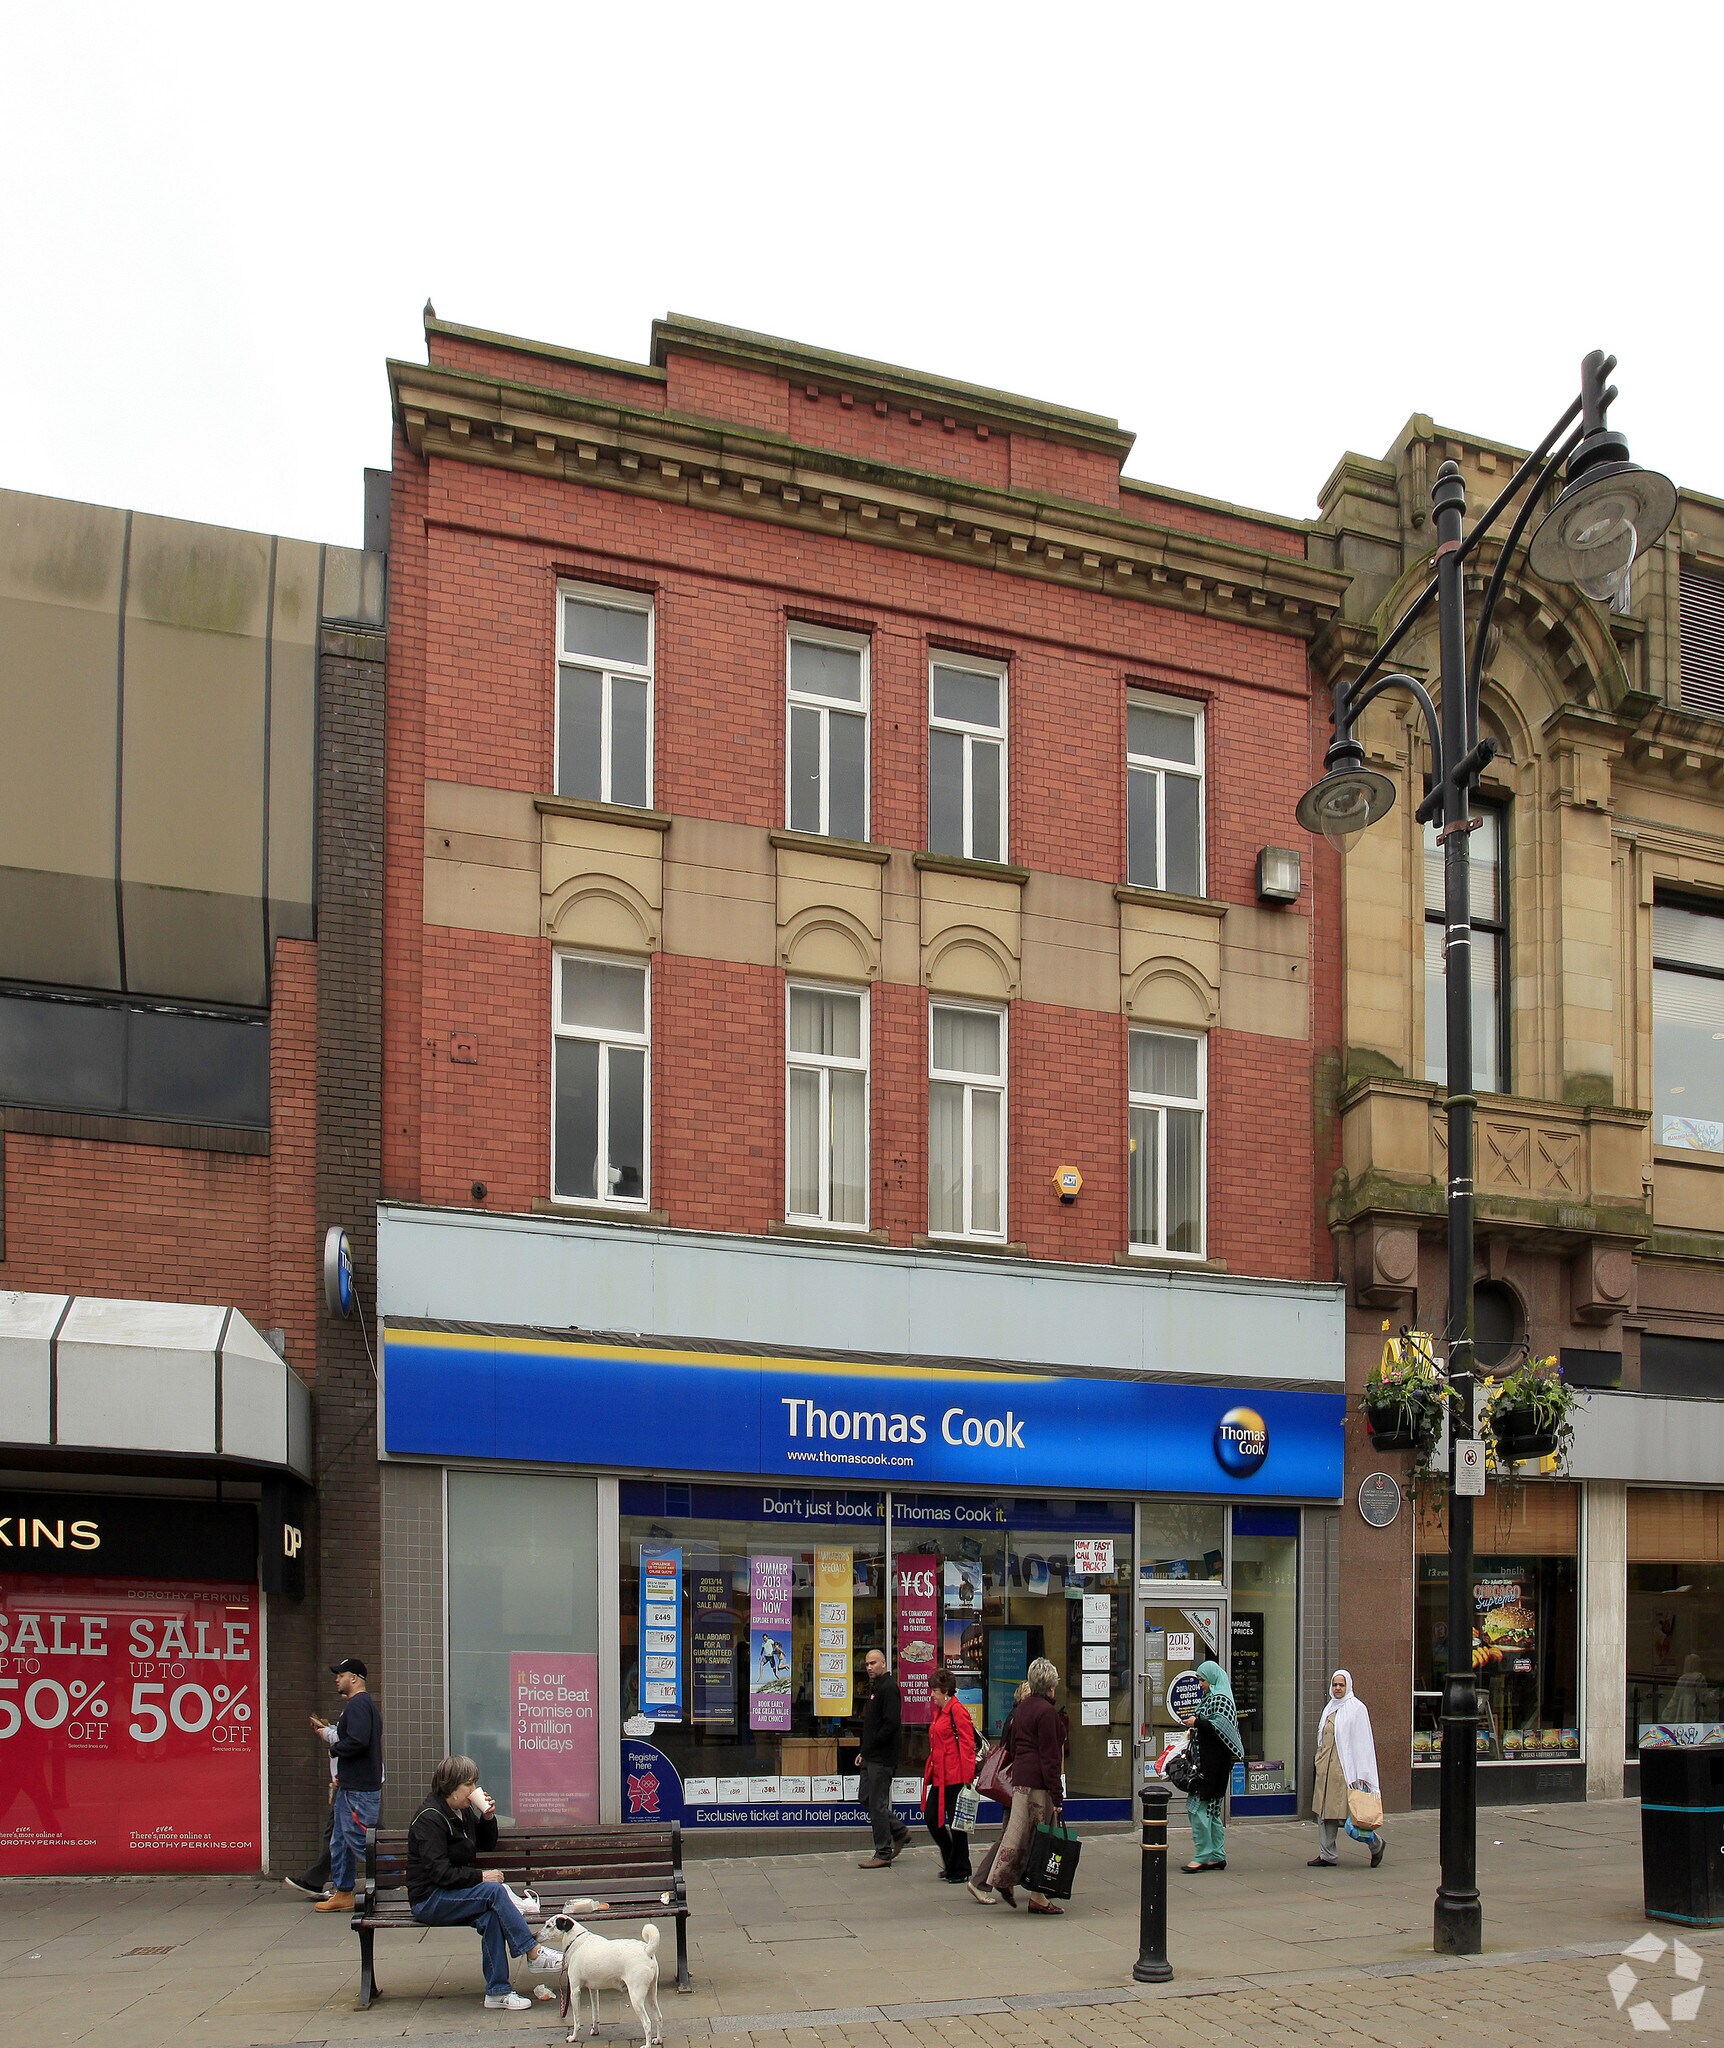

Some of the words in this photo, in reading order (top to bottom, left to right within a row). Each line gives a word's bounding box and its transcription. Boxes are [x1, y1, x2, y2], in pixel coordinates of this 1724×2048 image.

[1063, 1175, 1077, 1185] ADT
[781, 1397, 928, 1445] Thomas
[941, 1407, 1026, 1449] Cook
[1219, 1426, 1266, 1441] Thomas
[1238, 1440, 1265, 1456] Cook
[786, 1450, 914, 1467] www.thomascook.com
[762, 1497, 802, 1515] Don't
[804, 1499, 832, 1518] just
[835, 1500, 873, 1518] book
[894, 1503, 951, 1521] Thomas
[954, 1505, 992, 1522] Cook
[995, 1507, 1007, 1523] it.
[284, 1523, 302, 1559] DP
[1075, 1541, 1090, 1550] HOW
[1093, 1541, 1111, 1551] FAST
[1075, 1551, 1090, 1560] CAN
[1094, 1551, 1107, 1561] YOU
[755, 1562, 788, 1576] SUMMER
[821, 1562, 846, 1573] SPECIALS
[1082, 1561, 1107, 1572] PACK?
[700, 1577, 723, 1585] 2013/14
[762, 1576, 781, 1588] 2013
[699, 1585, 724, 1594] CRUISES
[756, 1588, 767, 1601] ON
[769, 1589, 788, 1602] SALE
[127, 1590, 188, 1600] DOROTHY
[193, 1593, 250, 1603] PERKINS
[707, 1593, 717, 1601] ON
[696, 1601, 712, 1609] SALE
[762, 1602, 782, 1614] NOW
[1475, 1594, 1517, 1612] Supreme
[654, 1613, 672, 1621] £449
[753, 1616, 769, 1624] EXPLORE
[784, 1617, 791, 1625] US
[1191, 1611, 1215, 1641] MoneyGram
[694, 1633, 706, 1641] ALL
[706, 1633, 731, 1641] ABOARD
[1233, 1628, 1254, 1636] PRICES
[128, 1618, 251, 1661] SALE
[703, 1641, 716, 1649] FOR
[1168, 1634, 1190, 1646] 2013
[692, 1649, 733, 1657] GUARANTEED
[1239, 1649, 1259, 1658] Change
[13, 1657, 41, 1675] TO
[694, 1657, 708, 1665] 10%
[129, 1661, 155, 1679] UP
[158, 1662, 186, 1679] TO
[517, 1669, 527, 1684] it
[529, 1669, 541, 1685] is
[542, 1673, 567, 1685] our
[517, 1686, 554, 1701] Price
[557, 1687, 590, 1702] Beat
[1179, 1691, 1198, 1699] cruises
[758, 1700, 771, 1708] BOOK
[770, 1700, 784, 1708] EARLY
[1181, 1698, 1192, 1706] sale
[128, 1682, 252, 1743] 50%
[517, 1702, 573, 1718] Promise
[575, 1706, 593, 1718] on
[752, 1707, 762, 1715] FOR
[761, 1707, 776, 1715] GREAT
[67, 1721, 109, 1740] OFF
[517, 1719, 527, 1734] 3
[530, 1719, 572, 1734] million
[211, 1725, 252, 1743] OFF
[517, 1735, 573, 1754] holidays
[628, 1752, 659, 1763] Register
[635, 1761, 652, 1770] here
[1250, 1773, 1270, 1783] open
[1250, 1781, 1281, 1792] sundays
[696, 1809, 748, 1822] Exclusive
[749, 1809, 780, 1821] ticket
[781, 1809, 803, 1821] and
[805, 1809, 831, 1821] hotel
[35, 1830, 55, 1838] online
[129, 1831, 157, 1840] There's
[179, 1831, 203, 1840] online
[1048, 1860, 1061, 1870] MY
